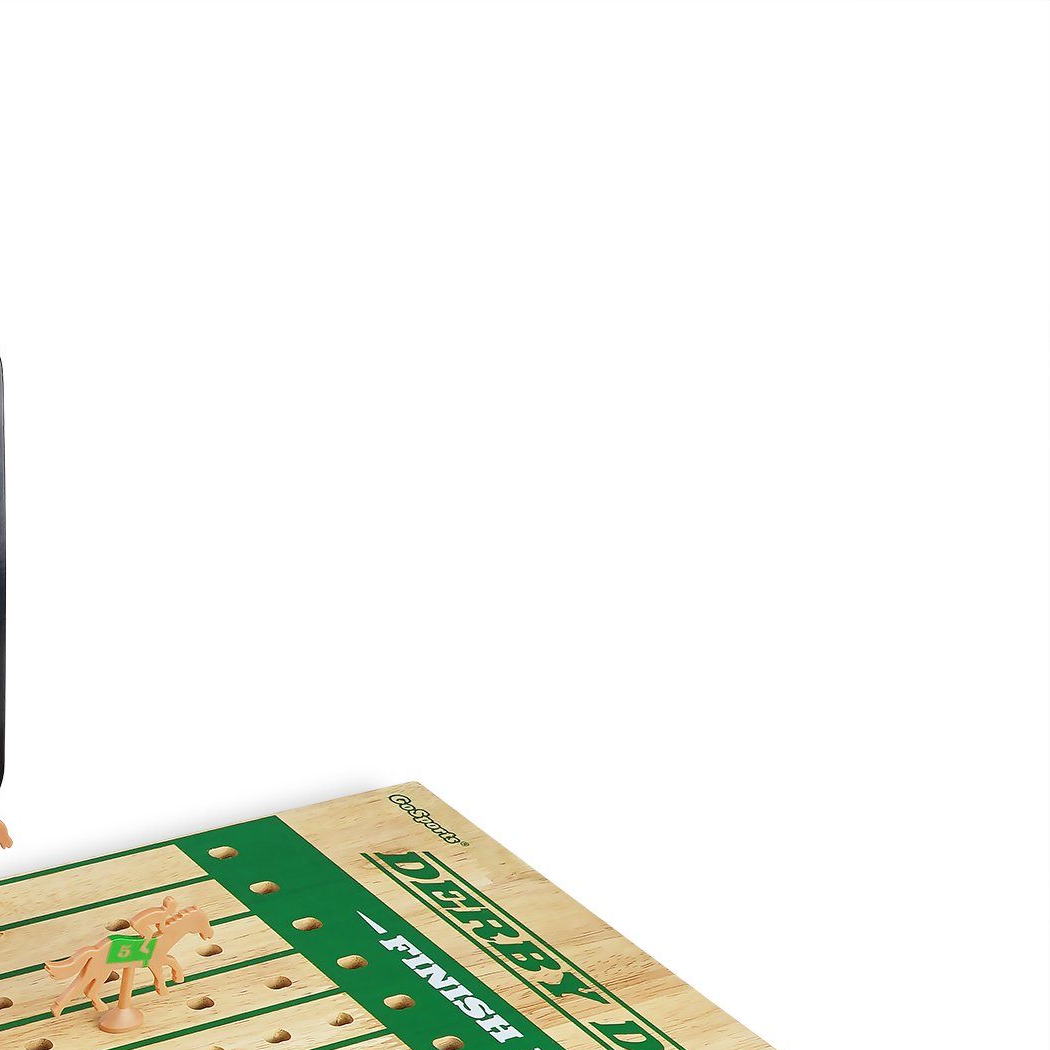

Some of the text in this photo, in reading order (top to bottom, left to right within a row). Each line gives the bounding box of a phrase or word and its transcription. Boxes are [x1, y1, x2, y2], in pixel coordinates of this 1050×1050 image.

[117, 945, 131, 958] 5
[374, 851, 611, 1005] DERBY
[380, 934, 524, 1044] FINISH
